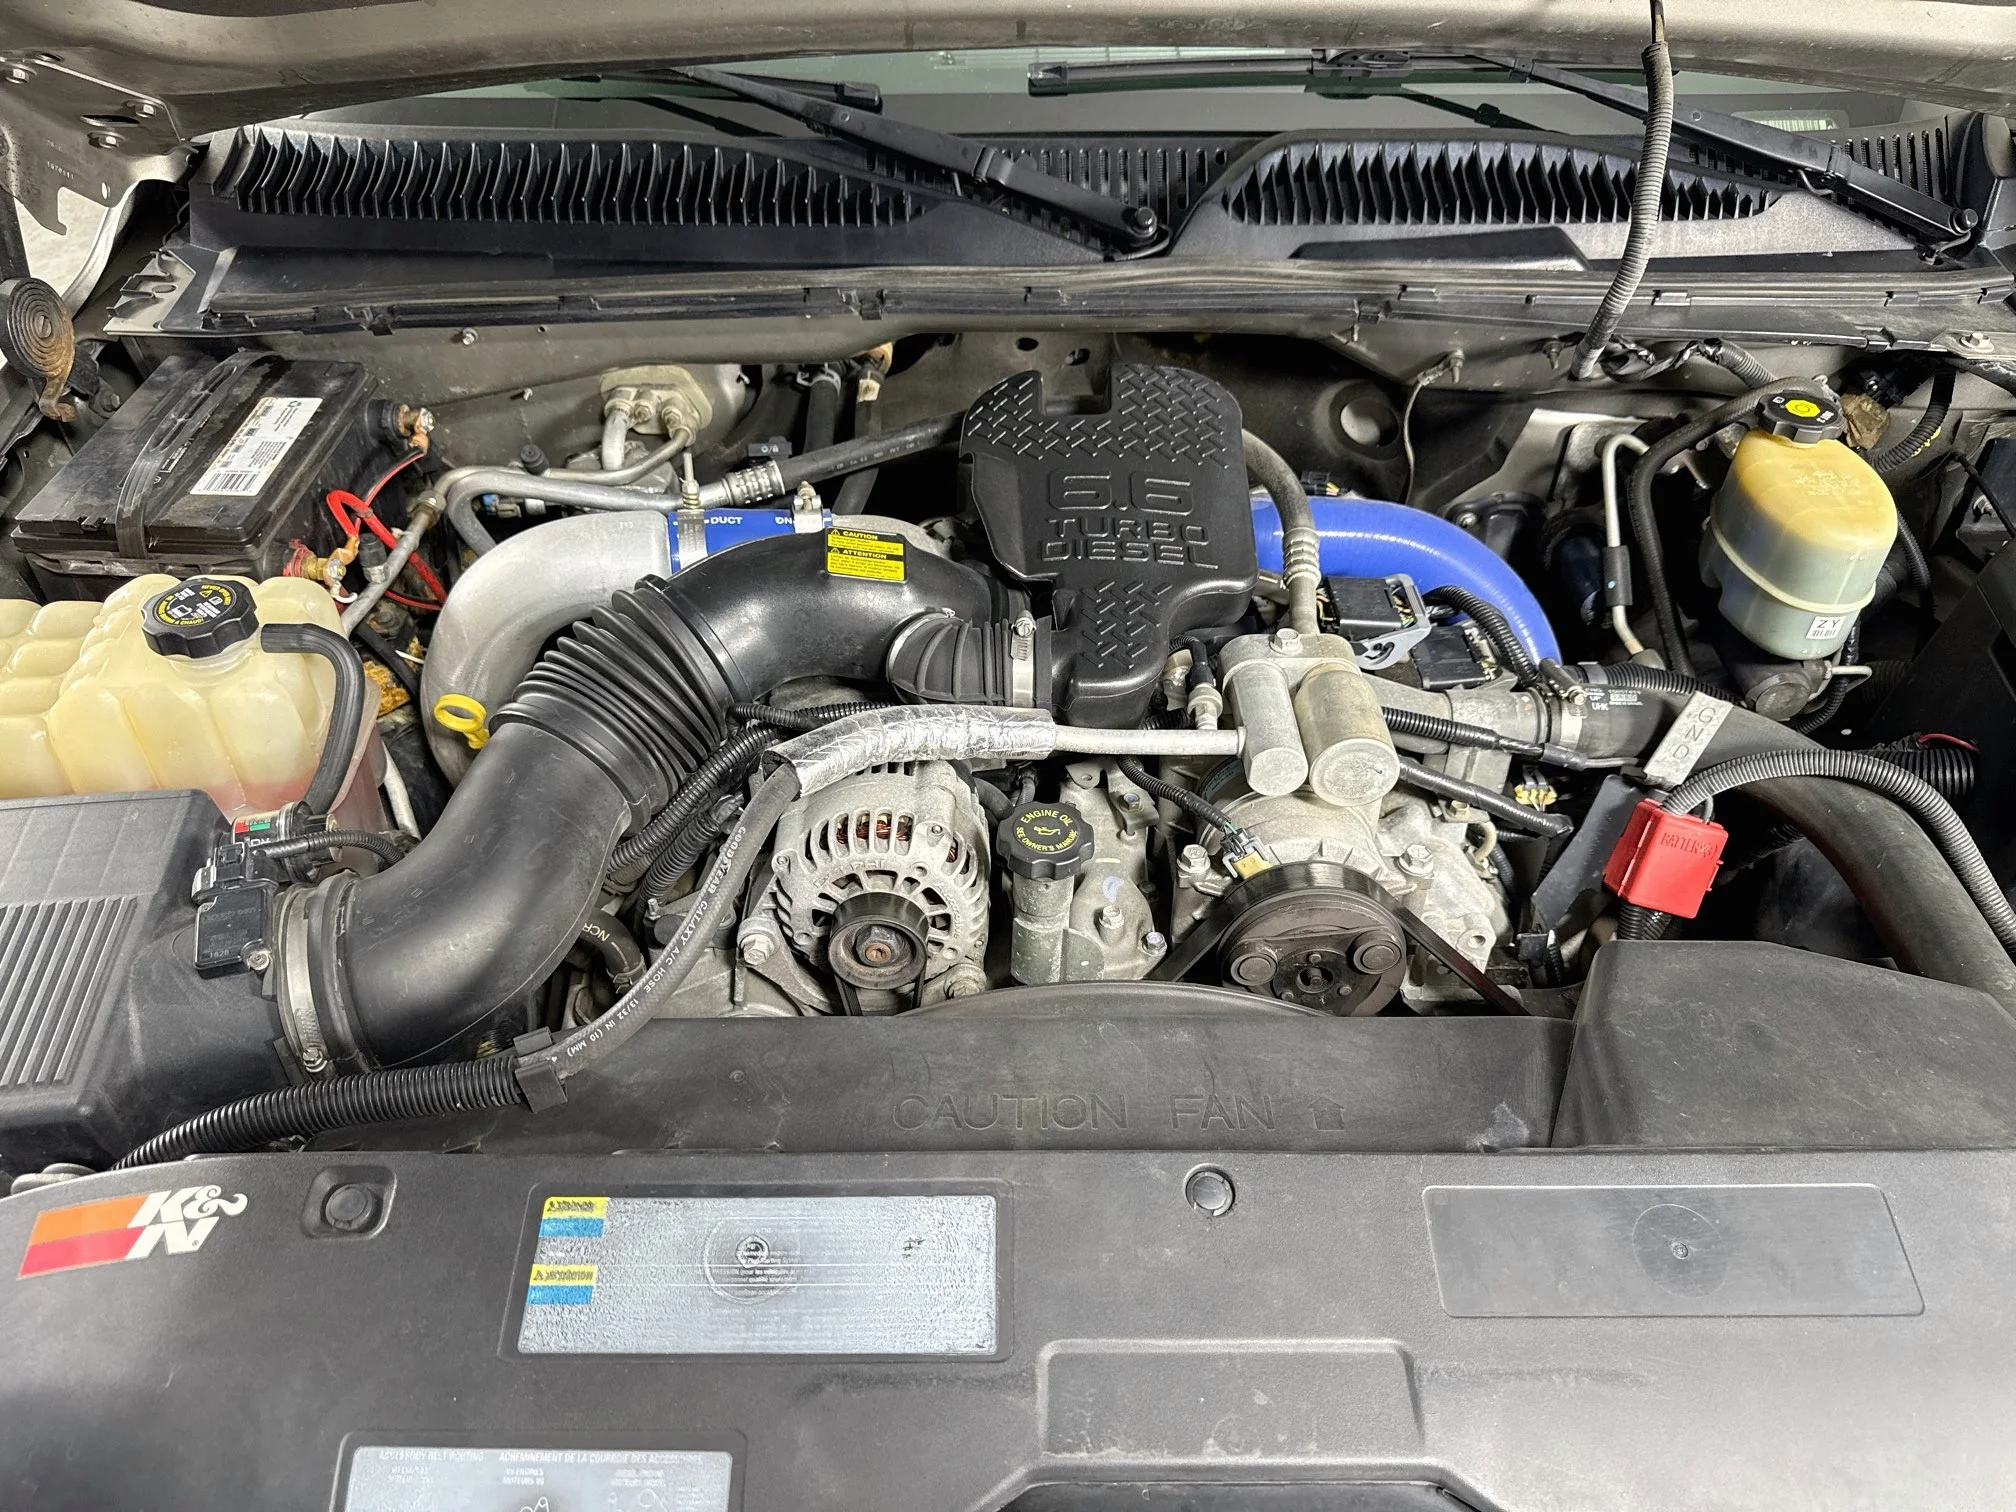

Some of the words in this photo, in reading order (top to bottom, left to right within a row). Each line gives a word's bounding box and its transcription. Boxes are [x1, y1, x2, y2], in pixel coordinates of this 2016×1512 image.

[1048, 470, 1195, 516] 6.6
[710, 516, 743, 525] DUCT
[1047, 517, 1210, 546] TURBO
[842, 530, 879, 541] CAUTION
[842, 549, 888, 560] ATTENTION
[1041, 540, 1220, 570] DIESEL
[1020, 809, 1060, 824] ENGINE
[1059, 814, 1074, 827] OIL
[1022, 837, 1055, 851] OWNER'S
[680, 899, 709, 947] GALAXY
[663, 946, 681, 967] A/C
[642, 966, 667, 994] HOSE
[615, 997, 640, 1020] 13/32
[604, 1017, 617, 1031] IN
[566, 1040, 588, 1057] MM)
[891, 1093, 1129, 1131] CAUTION
[1168, 1093, 1277, 1131] FAN
[125, 1184, 249, 1261] K&N
